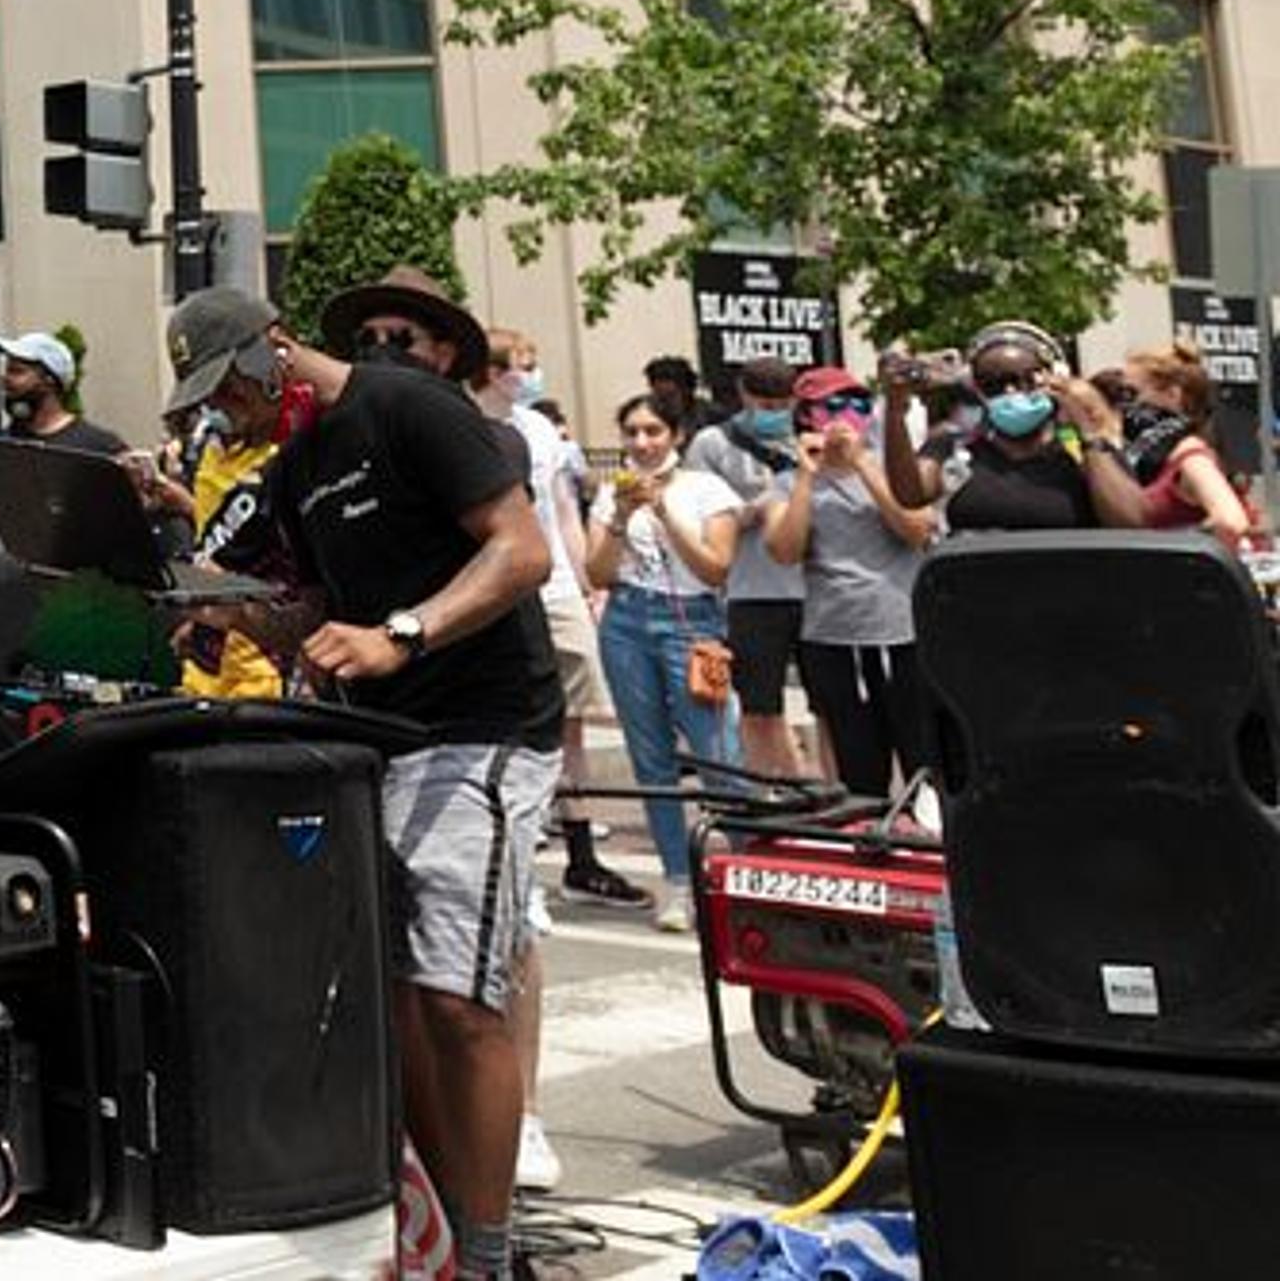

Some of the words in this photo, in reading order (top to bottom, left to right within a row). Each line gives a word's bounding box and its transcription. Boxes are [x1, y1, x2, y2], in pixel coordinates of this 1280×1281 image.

[698, 293, 767, 327] BLACK
[769, 297, 827, 330] LIVE
[722, 331, 814, 365] MATTER
